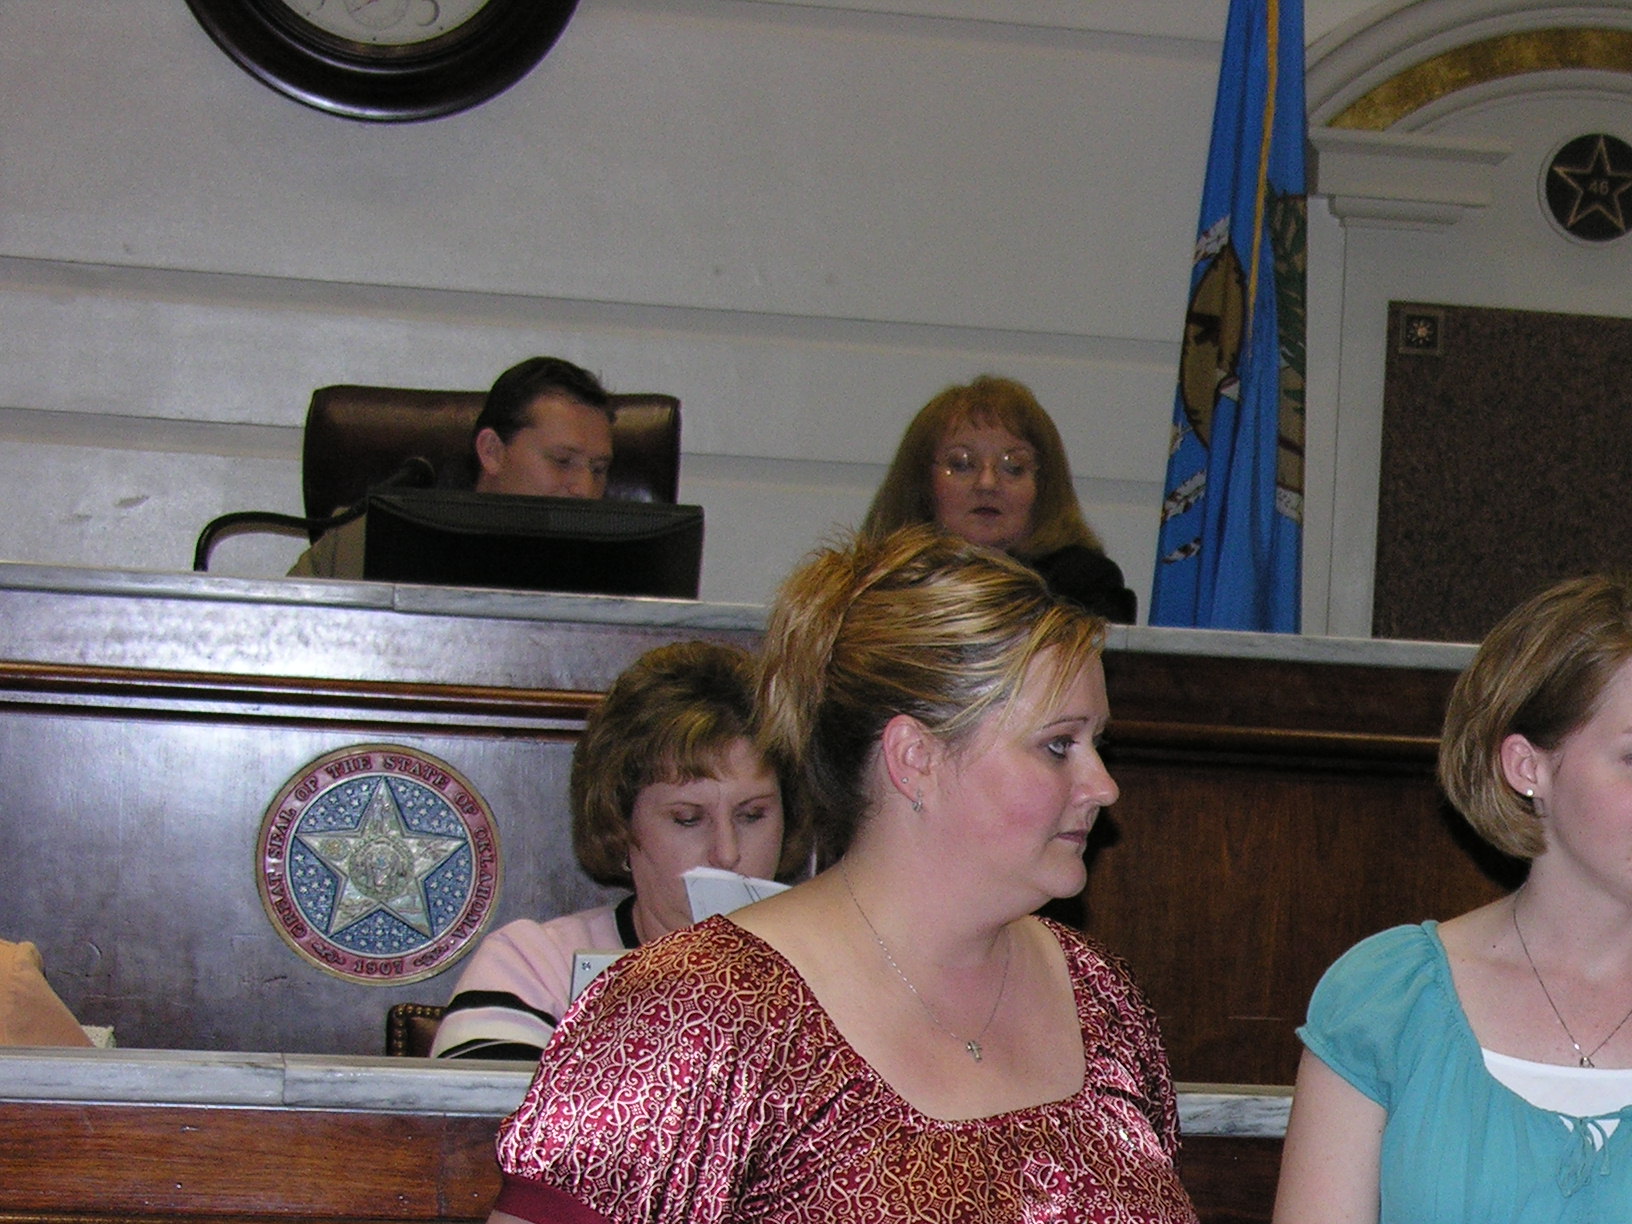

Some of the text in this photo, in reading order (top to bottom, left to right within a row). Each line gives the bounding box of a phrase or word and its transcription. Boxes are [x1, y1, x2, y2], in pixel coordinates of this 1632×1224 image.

[270, 755, 495, 940] GREAT SEAL OF THE STATE OF OKLAHOMA
[353, 960, 405, 976] 1907
